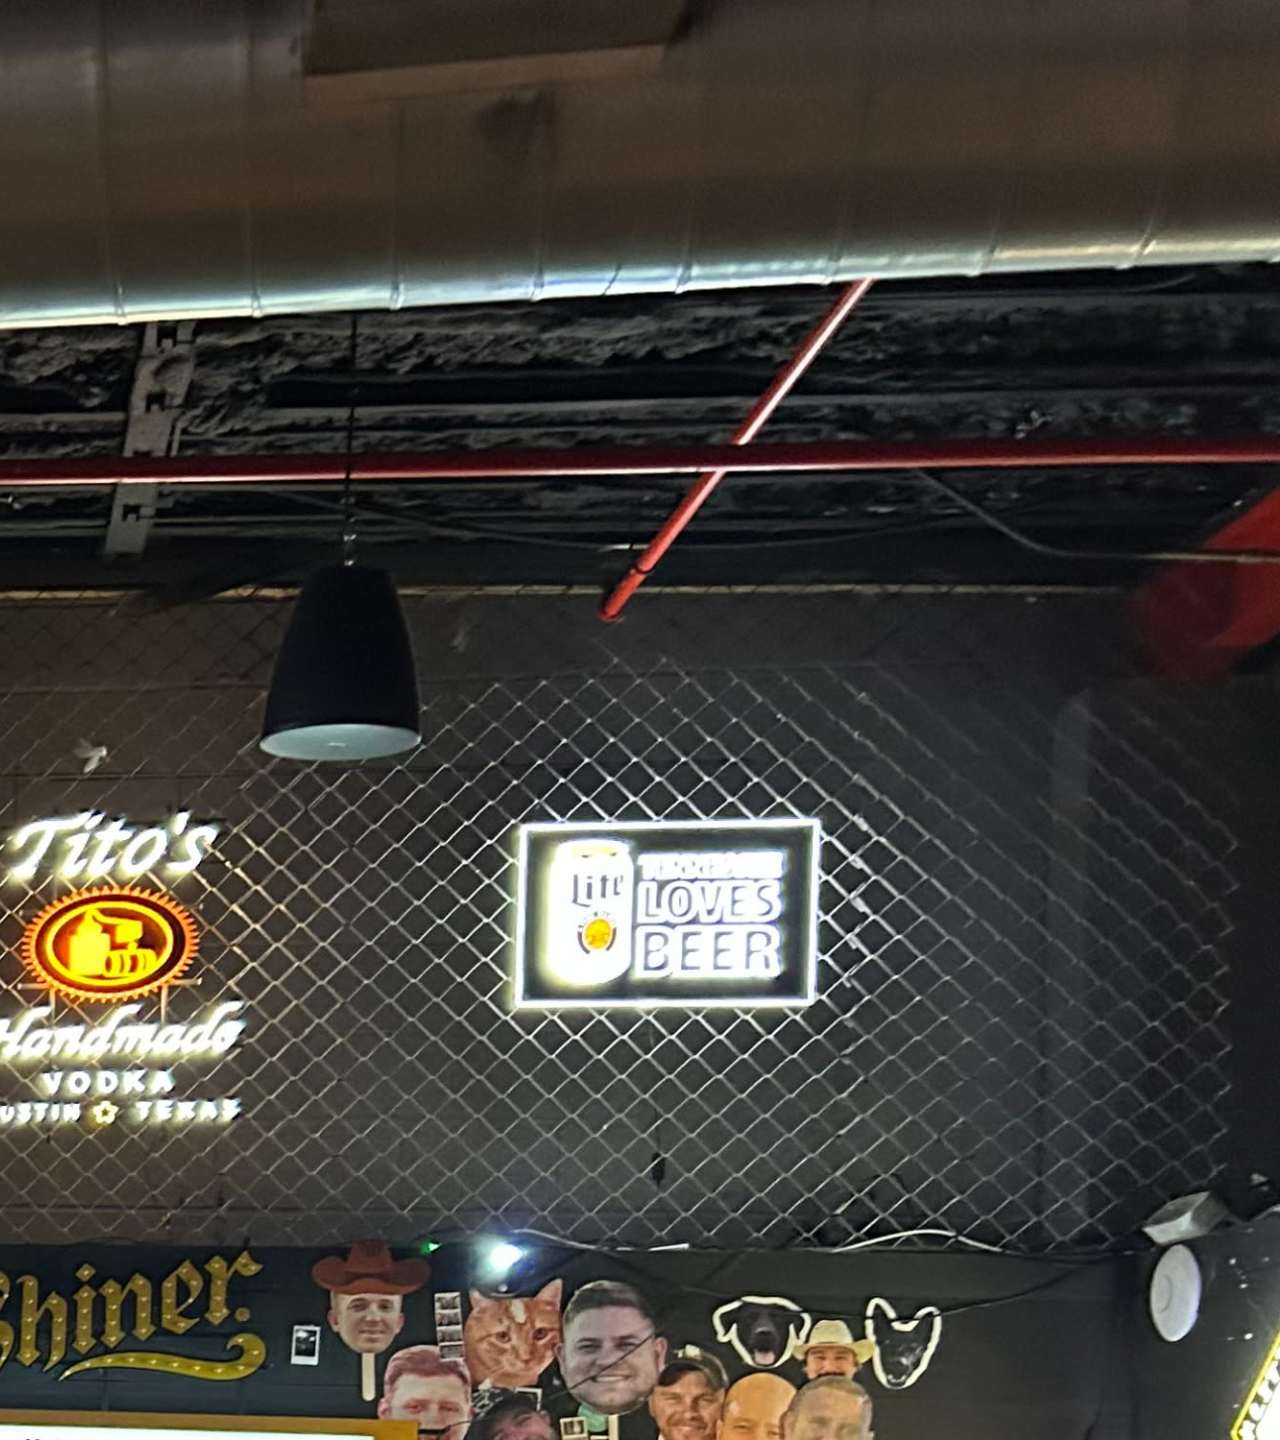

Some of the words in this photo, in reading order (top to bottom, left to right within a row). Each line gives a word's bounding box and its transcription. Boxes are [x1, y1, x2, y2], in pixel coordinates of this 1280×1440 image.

[7, 810, 220, 881] Tito's
[639, 880, 782, 923] LOVES
[636, 925, 784, 978] BEER
[42, 1069, 176, 1096] VODKA
[136, 1098, 242, 1124] TEXAS
